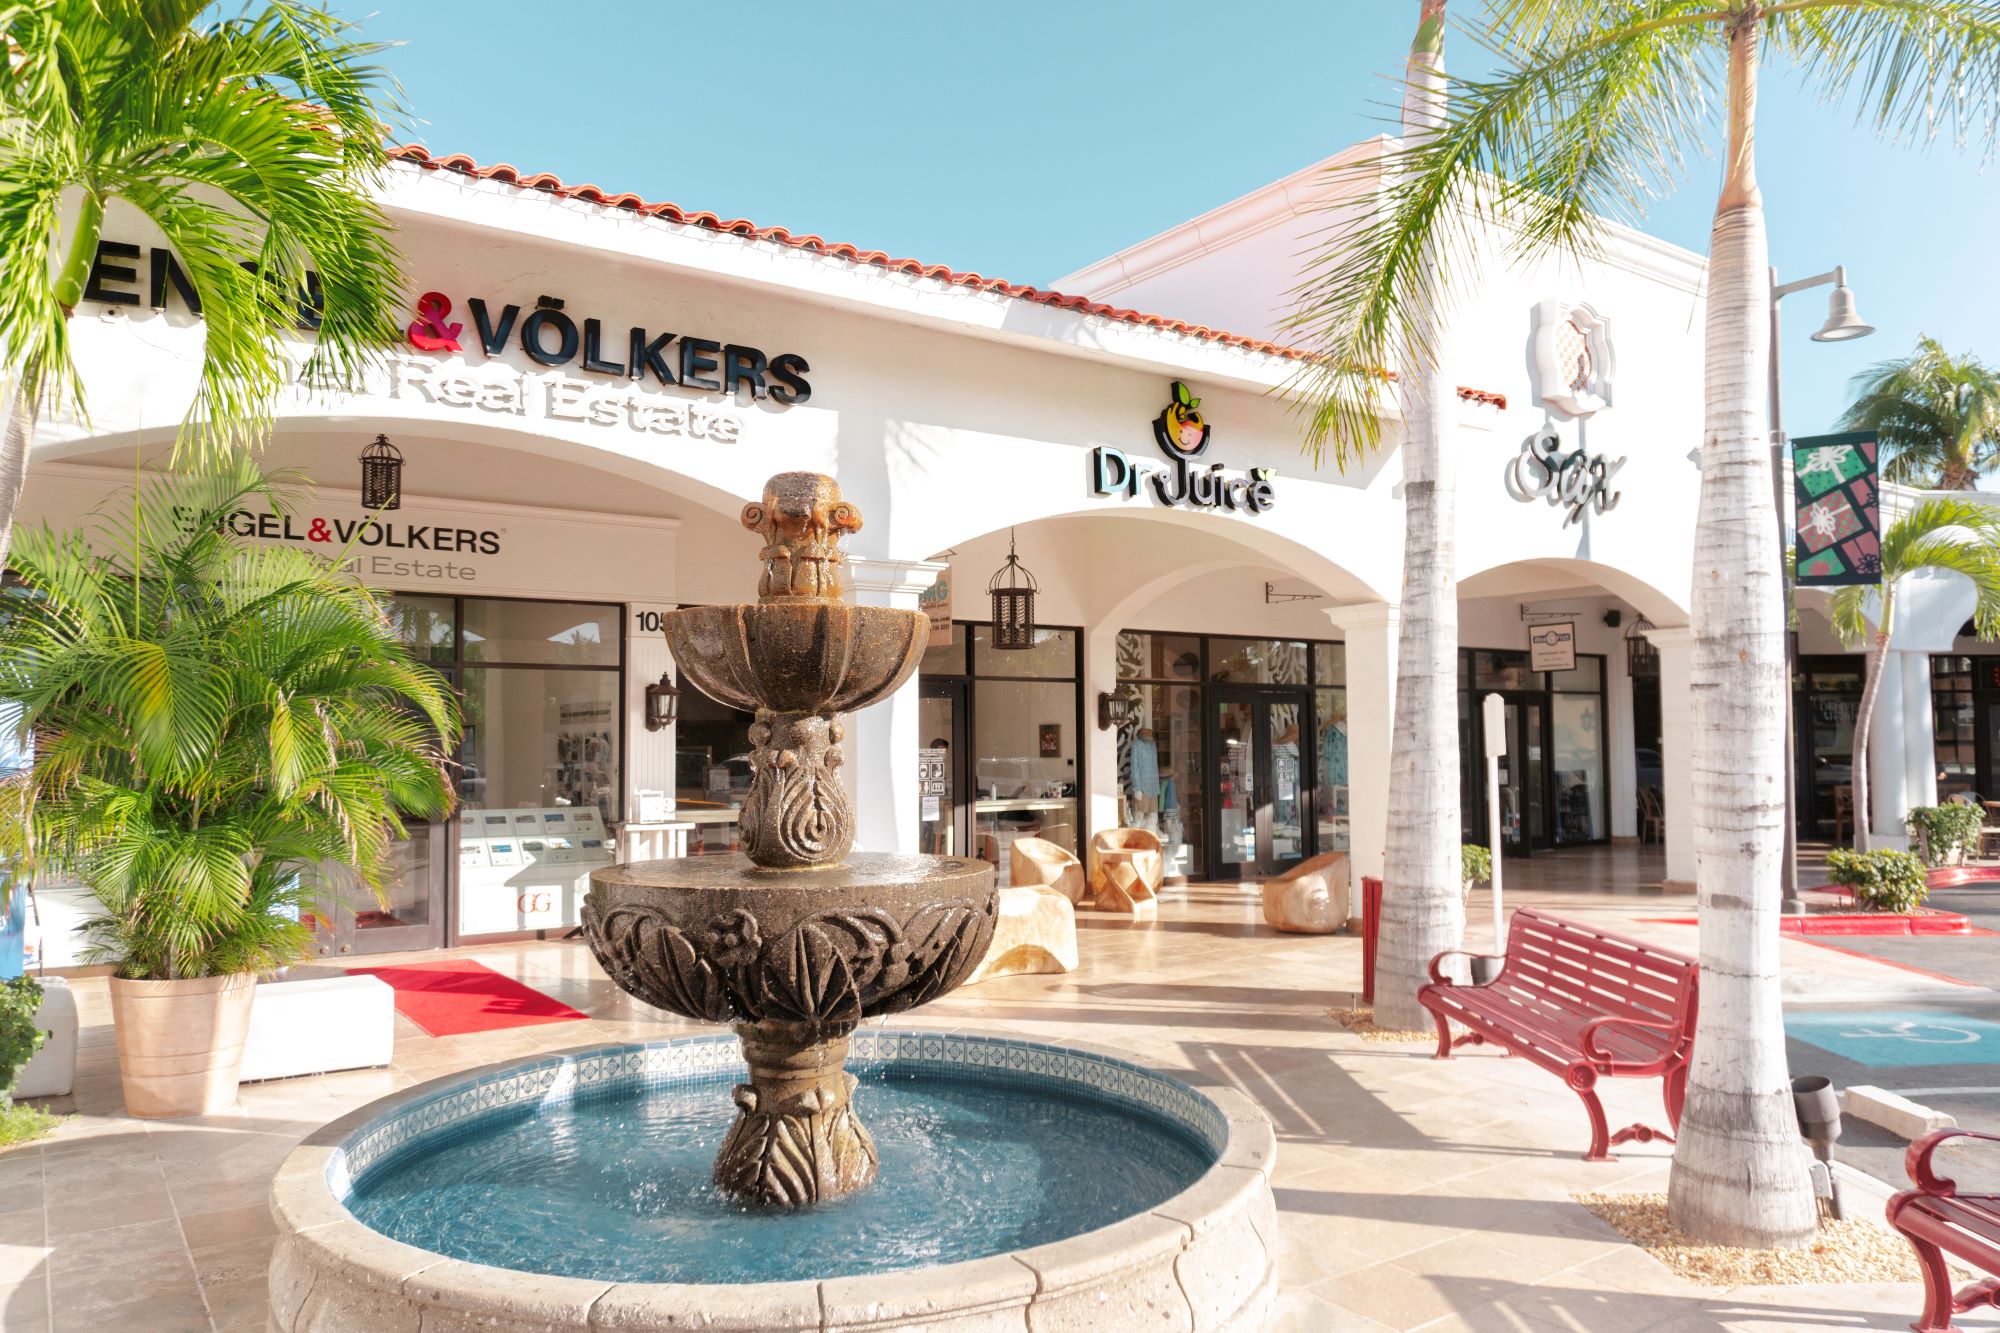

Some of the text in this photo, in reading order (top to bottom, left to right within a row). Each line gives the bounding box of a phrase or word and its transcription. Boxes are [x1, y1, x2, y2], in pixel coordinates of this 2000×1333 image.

[389, 353, 537, 417] Real
[544, 370, 748, 445] Estate
[1095, 446, 1276, 512] Dr Juice
[372, 556, 477, 580] Estate
